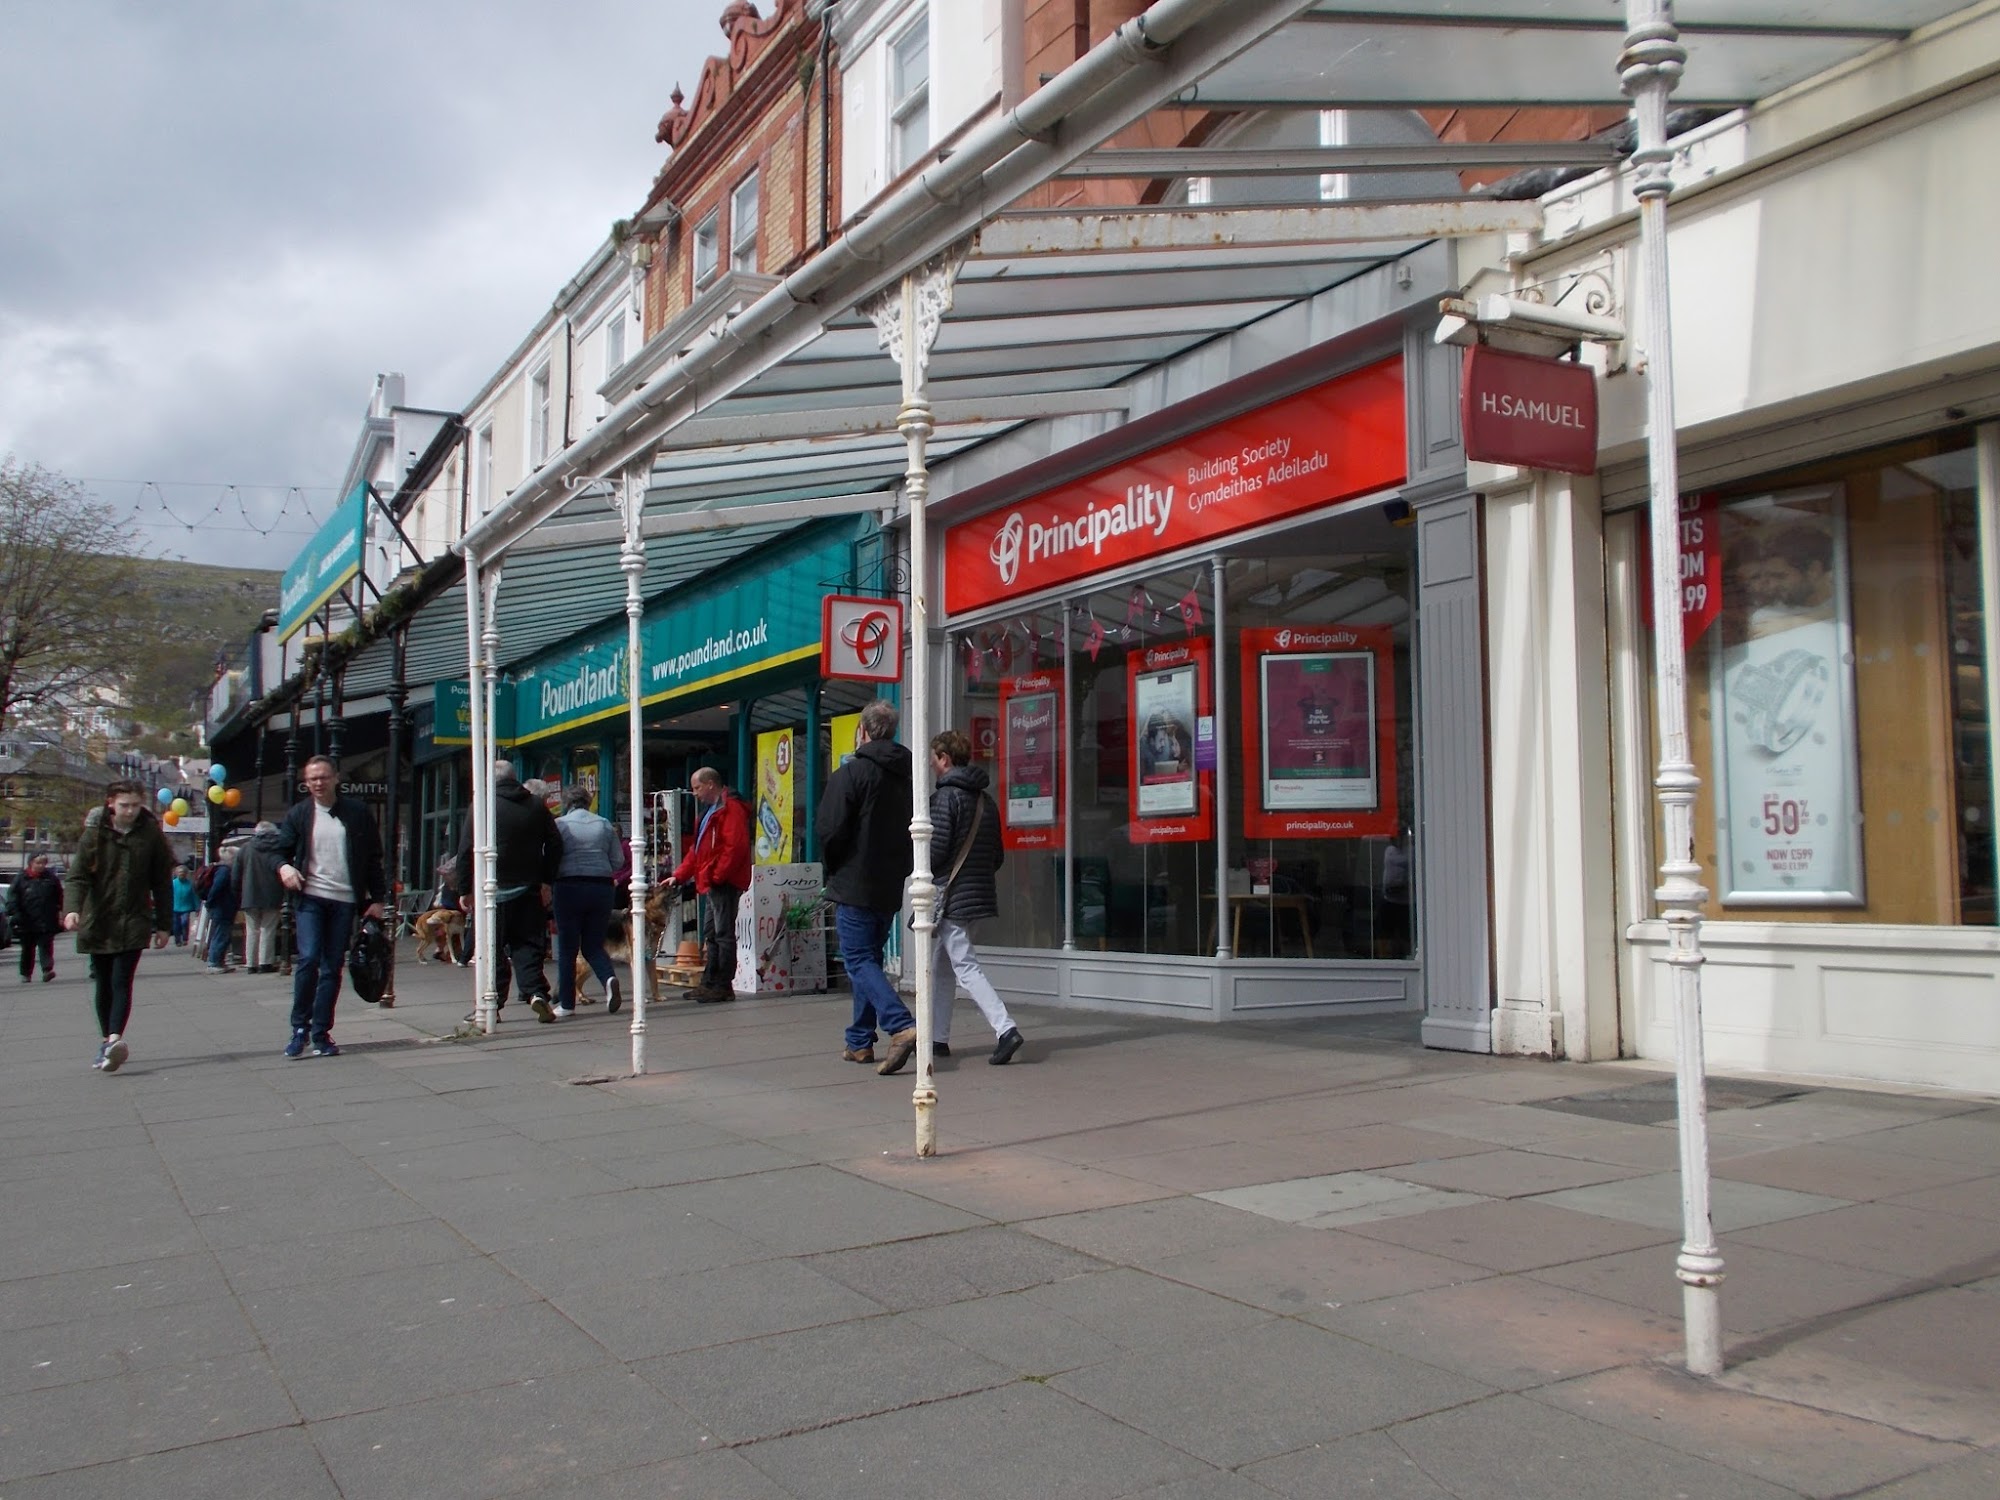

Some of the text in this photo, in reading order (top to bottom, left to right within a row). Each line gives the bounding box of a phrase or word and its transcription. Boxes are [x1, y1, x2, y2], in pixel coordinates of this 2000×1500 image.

[1482, 391, 1586, 429] H.SAMUEL
[1187, 437, 1291, 485] Building Society
[1188, 450, 1328, 514] Cymdeithas Adeiladu
[1028, 483, 1175, 563] Principality
[652, 618, 768, 682] www.poundland.co.uk
[1294, 631, 1358, 645] Principality
[1154, 647, 1190, 661] Principality
[541, 653, 618, 720] Poundland
[1022, 676, 1051, 688] Principality
[777, 740, 788, 765] £1
[1286, 820, 1354, 831] principality.co.uk
[1766, 848, 1814, 860] NOW £599
[773, 878, 820, 889] John
